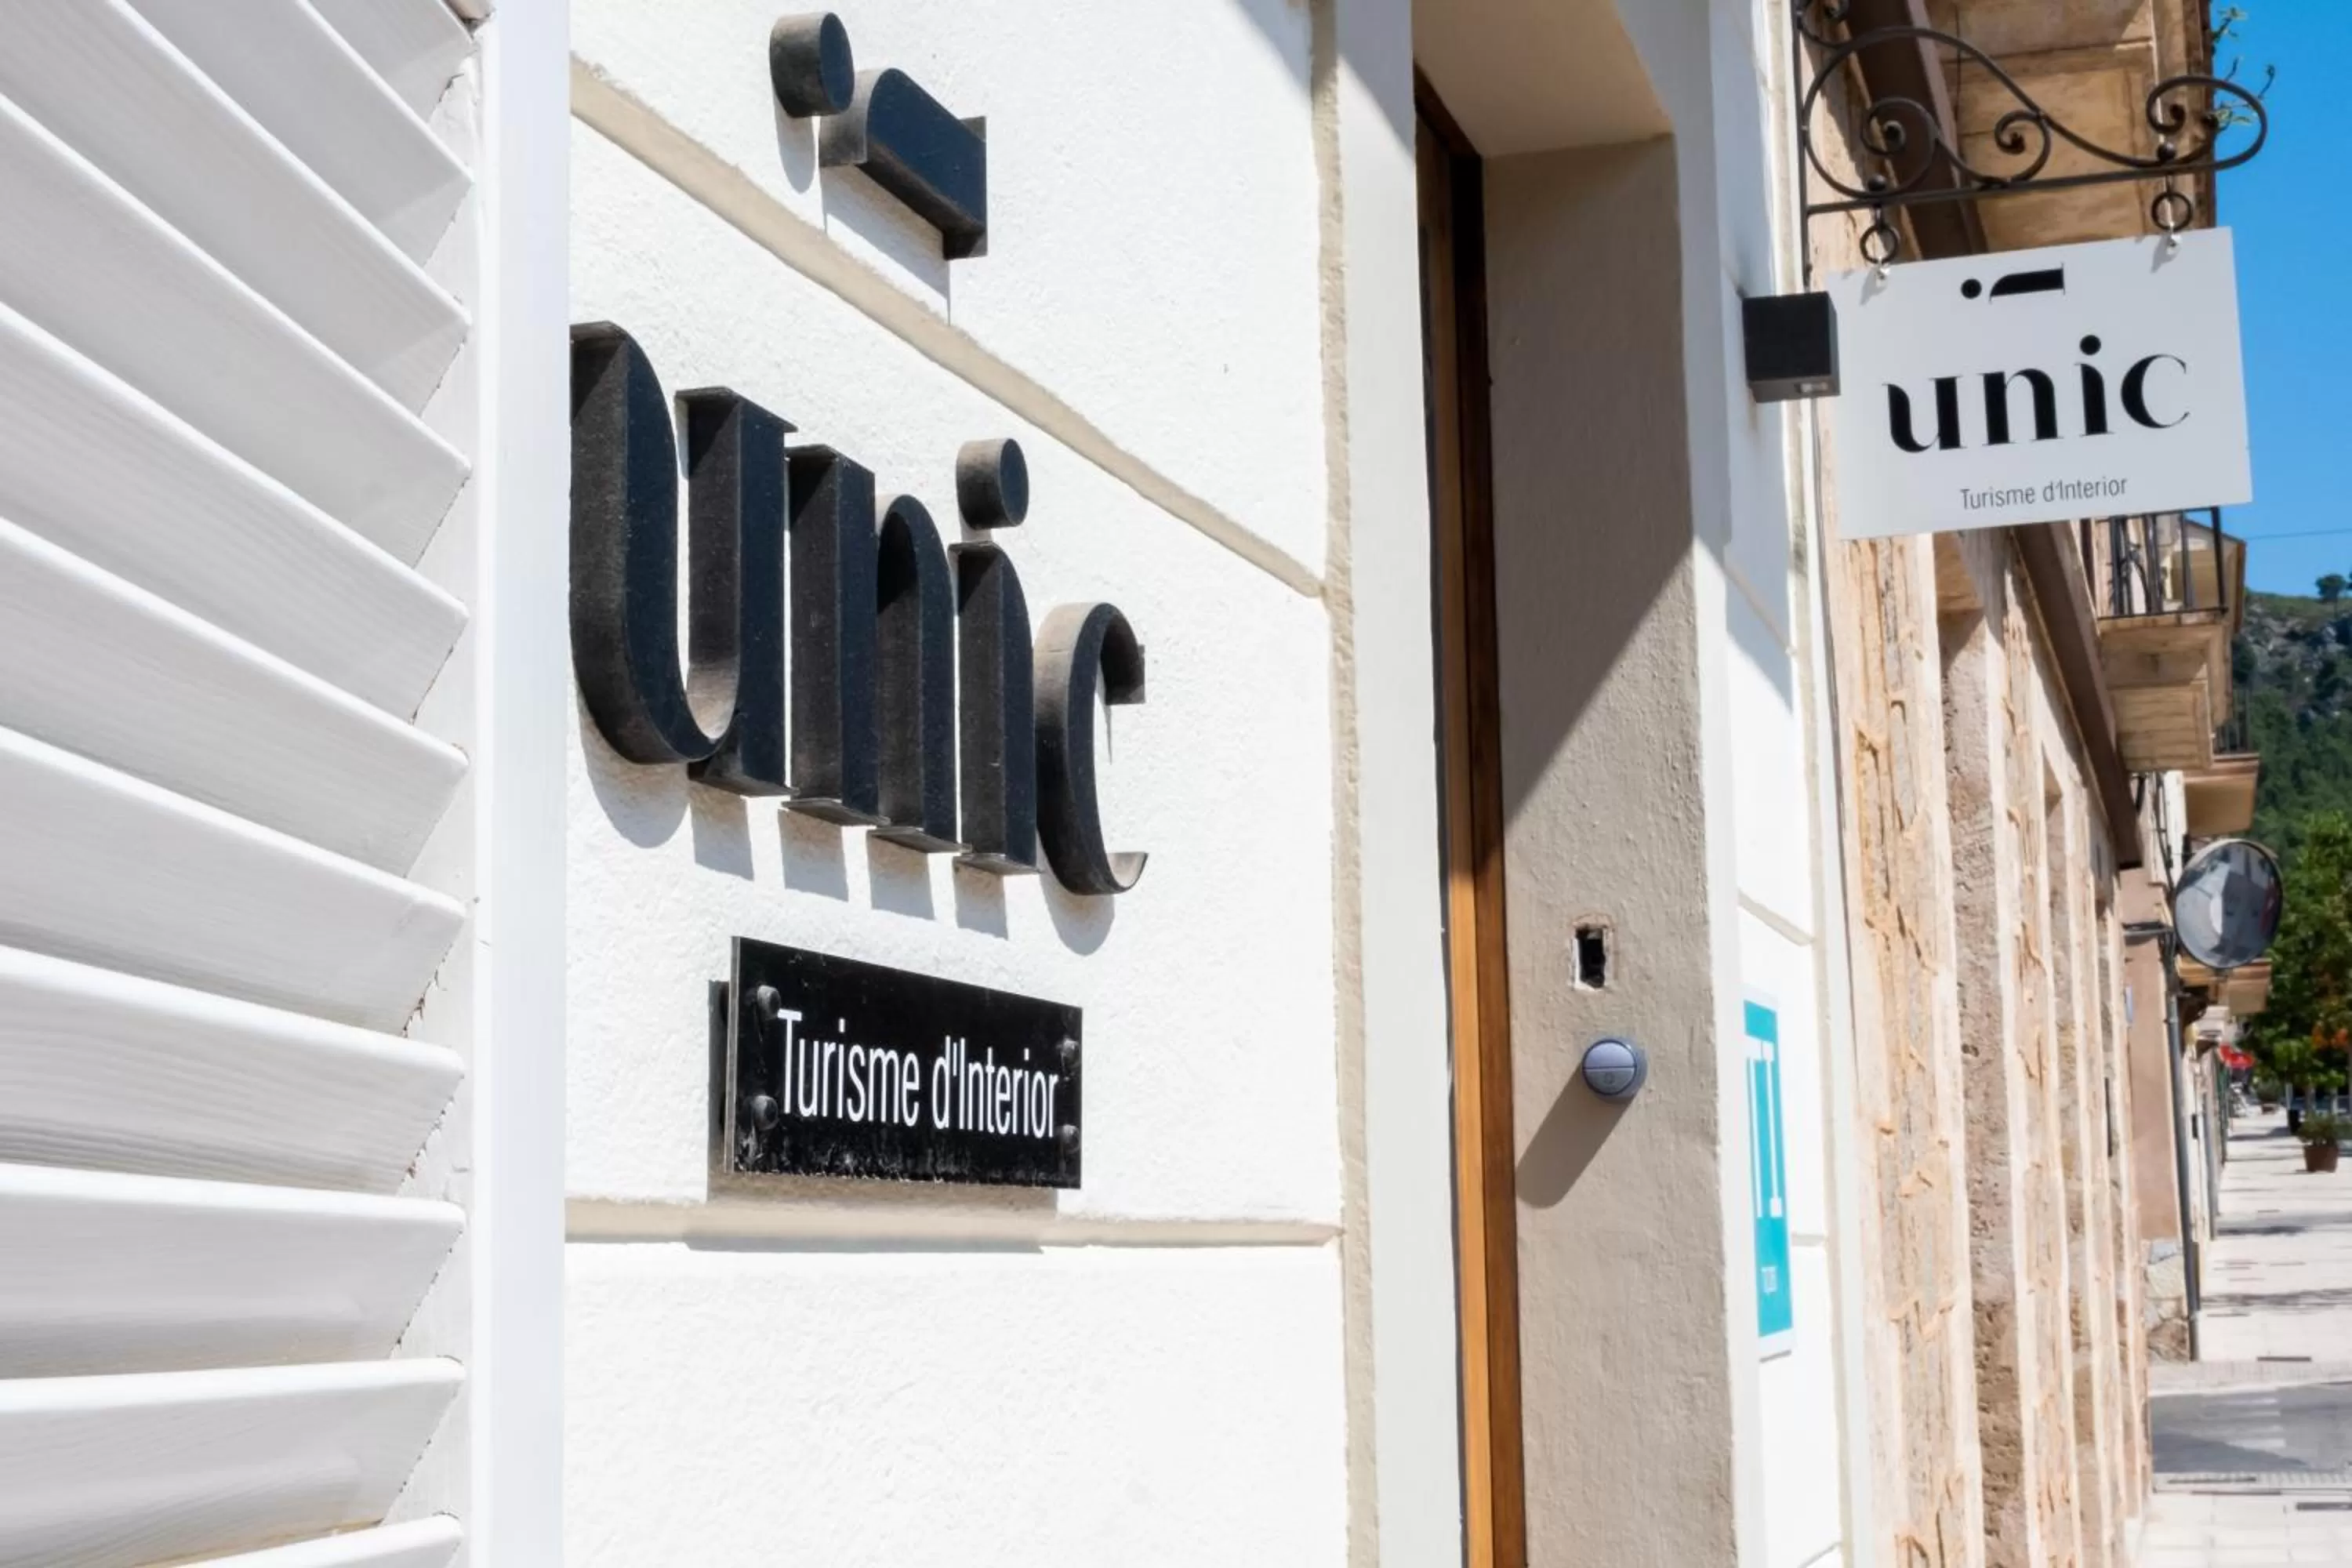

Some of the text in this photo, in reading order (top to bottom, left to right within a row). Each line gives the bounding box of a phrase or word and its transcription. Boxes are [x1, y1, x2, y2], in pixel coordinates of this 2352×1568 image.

[1883, 334, 2190, 453] unic
[1960, 475, 2128, 510] Turisme d'Interior
[777, 1009, 1058, 1138] Turisme d'Interior
